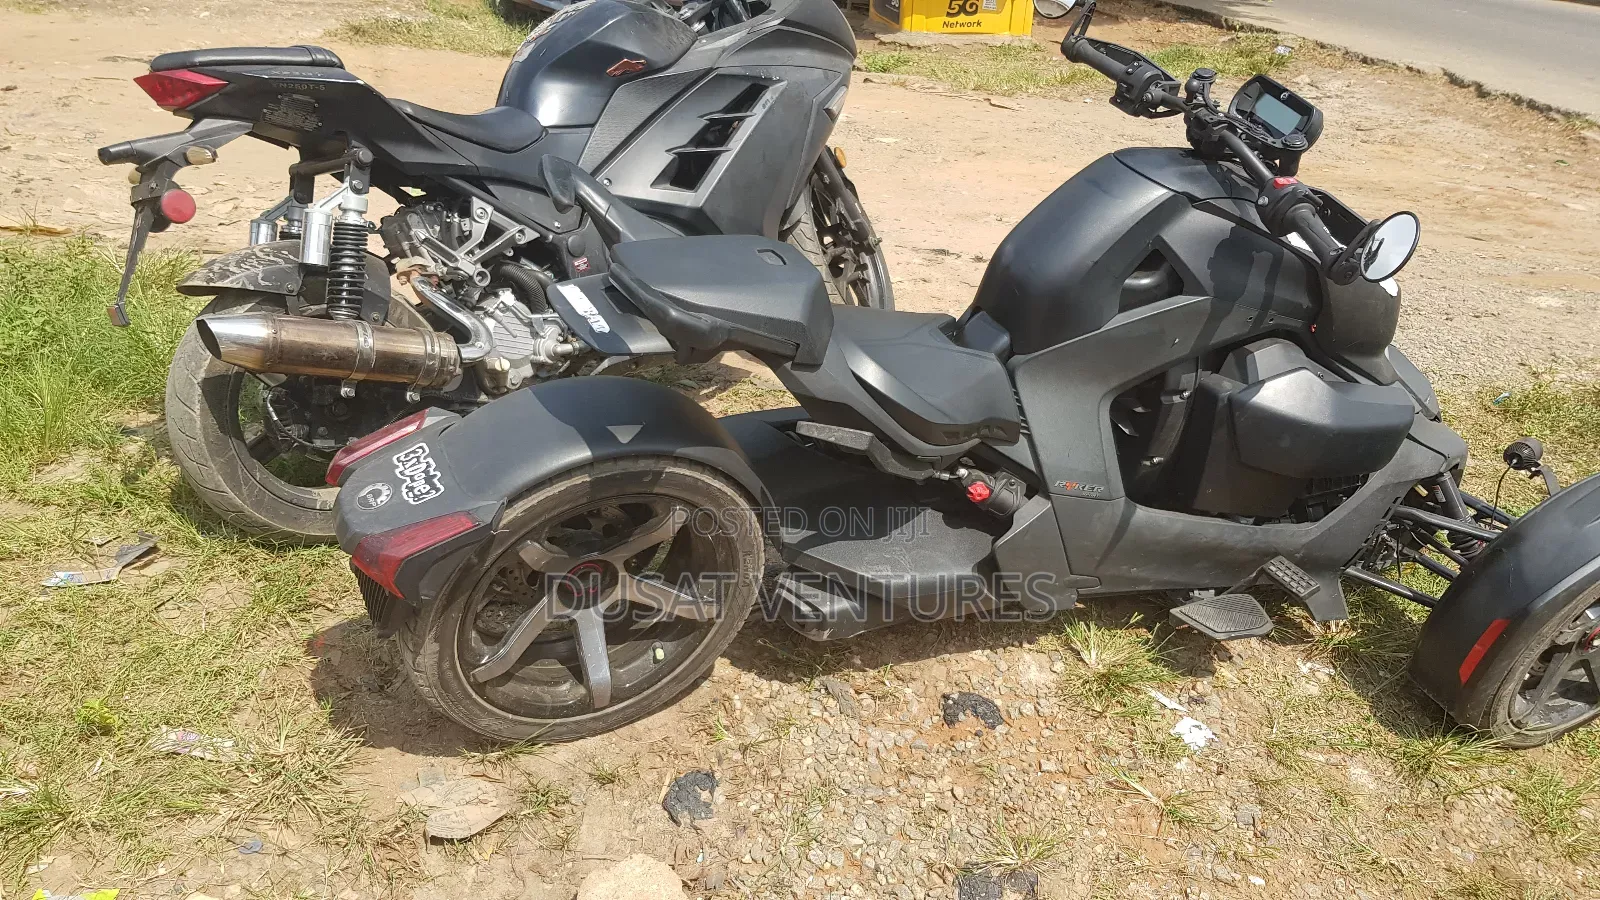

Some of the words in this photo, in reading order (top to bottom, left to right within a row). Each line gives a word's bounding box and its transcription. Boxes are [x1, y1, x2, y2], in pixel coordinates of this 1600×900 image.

[946, 0, 980, 18] 5G
[942, 20, 982, 28] Network
[366, 493, 377, 507] BRP
